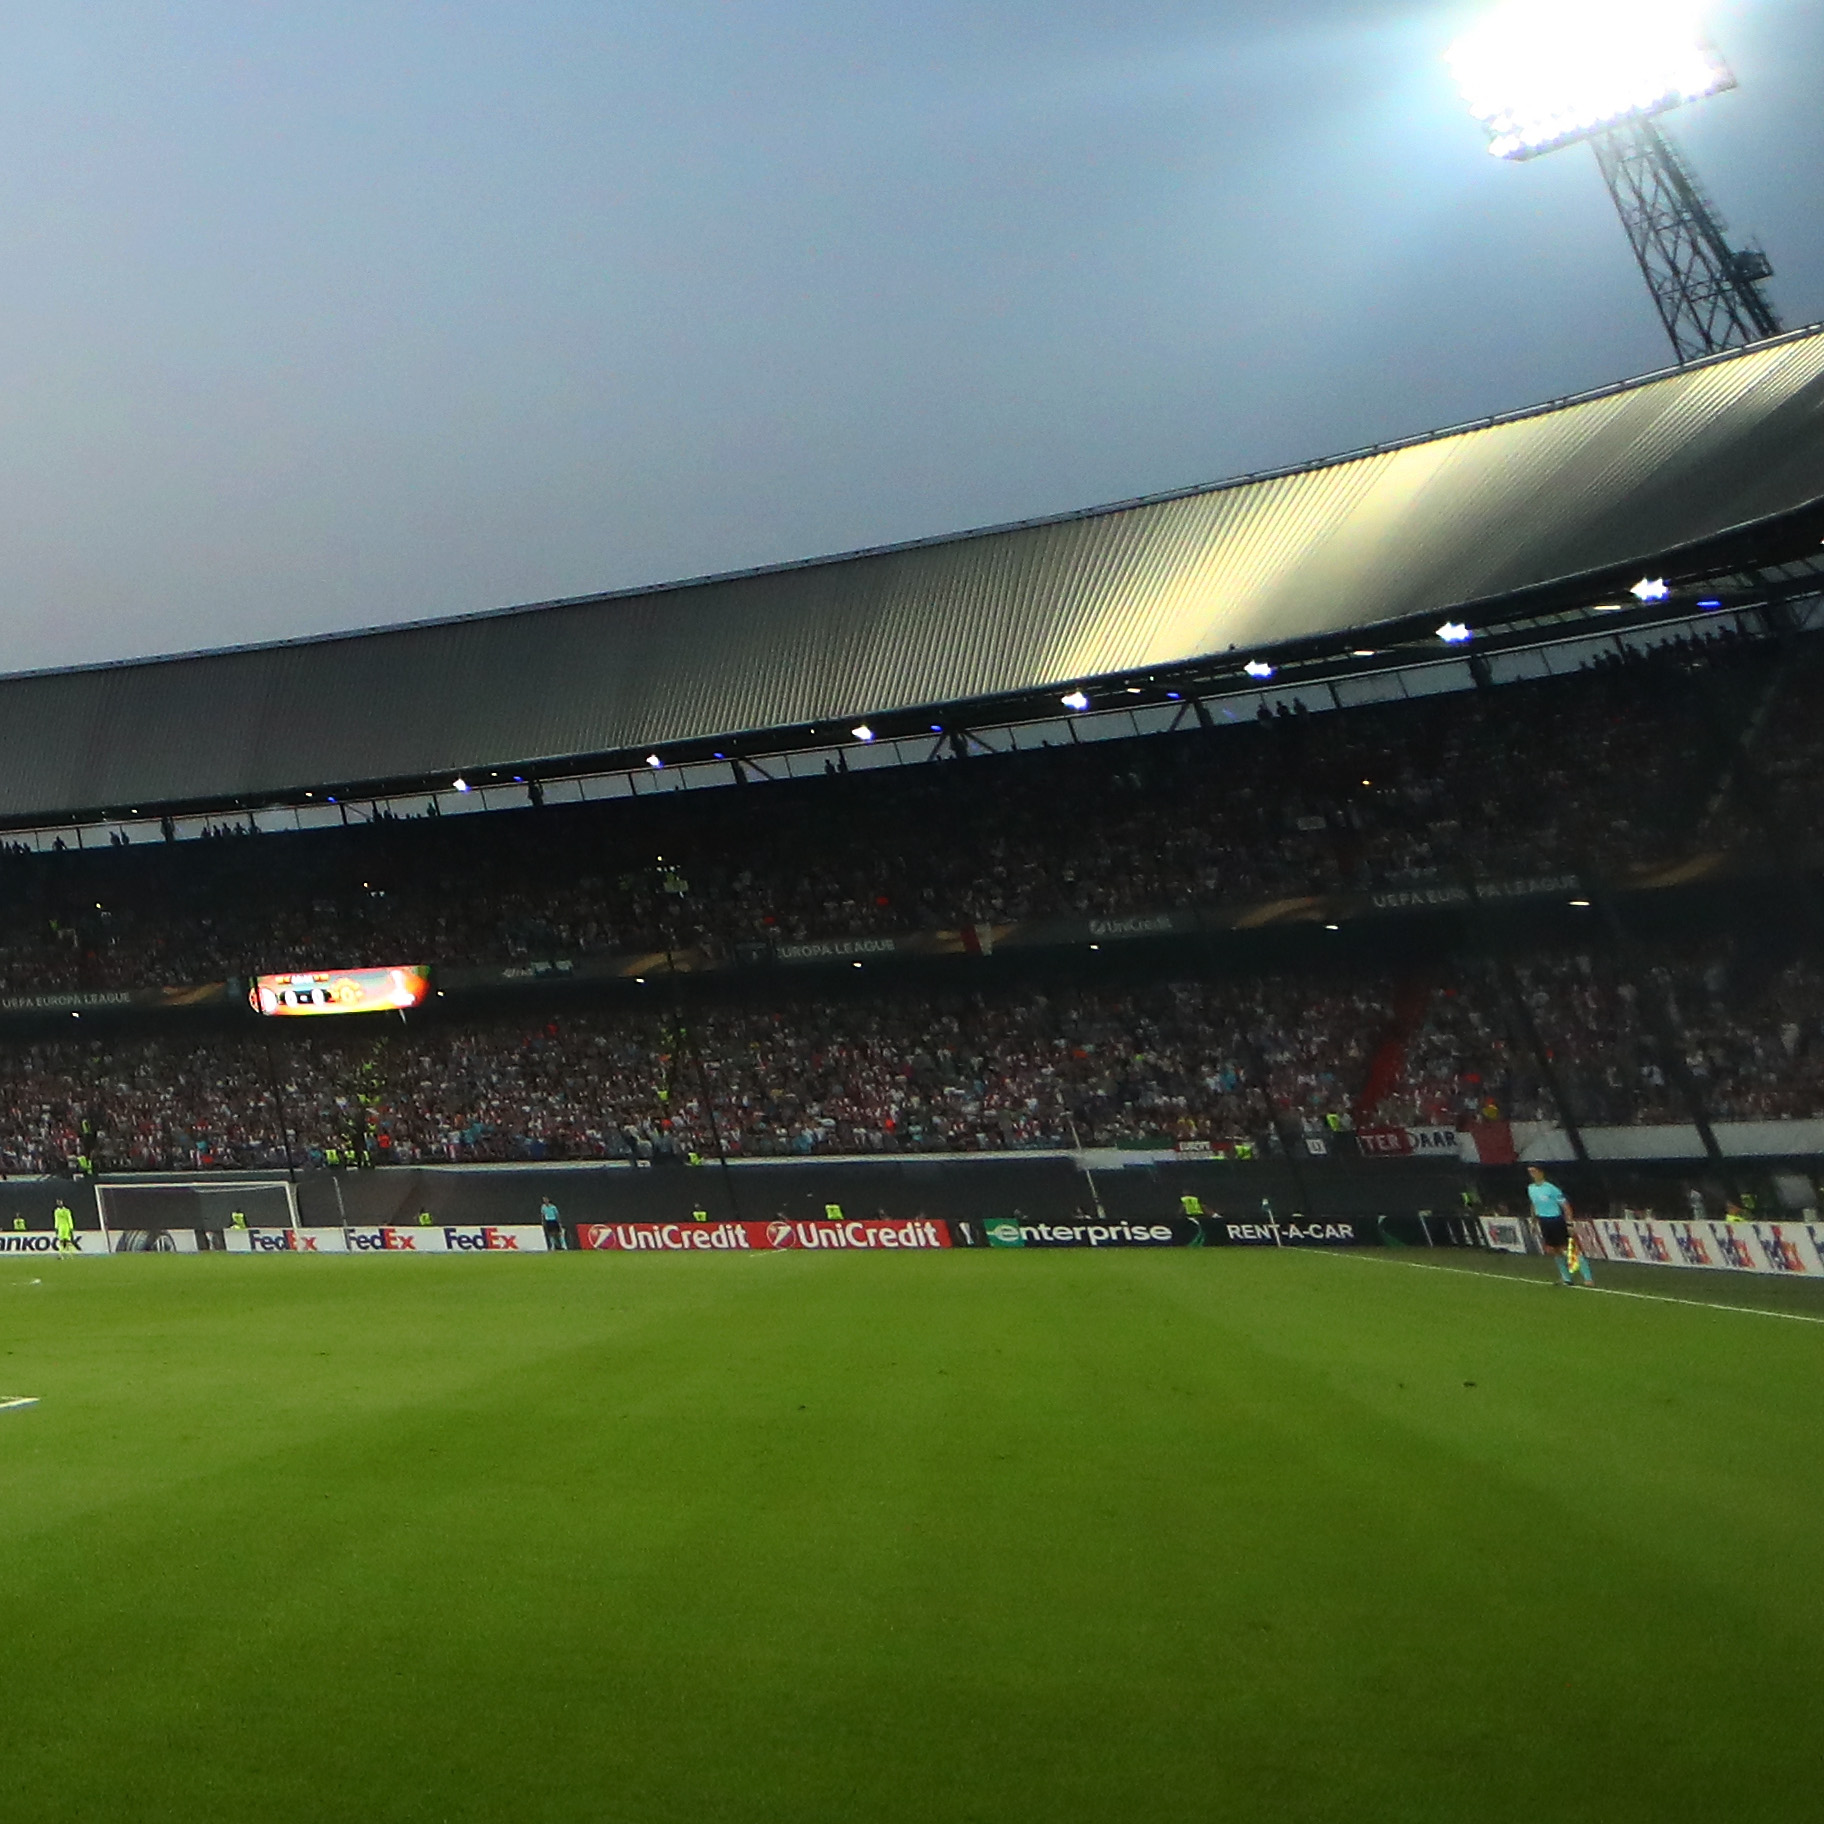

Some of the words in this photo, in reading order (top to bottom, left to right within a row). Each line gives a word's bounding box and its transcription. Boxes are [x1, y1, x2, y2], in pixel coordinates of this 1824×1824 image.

[2, 997, 34, 1009] UEFA
[36, 994, 82, 1008] EUROPA
[83, 991, 131, 1005] LEAGUE
[248, 1229, 318, 1251] FedEx
[342, 1228, 416, 1251] FedEx
[444, 1227, 520, 1251] FedEx
[616, 1224, 751, 1250] UniCredit
[795, 1222, 941, 1248] UniCredit
[989, 1221, 1173, 1246] enterprise
[1226, 1222, 1355, 1239] RENT-A-CAR
